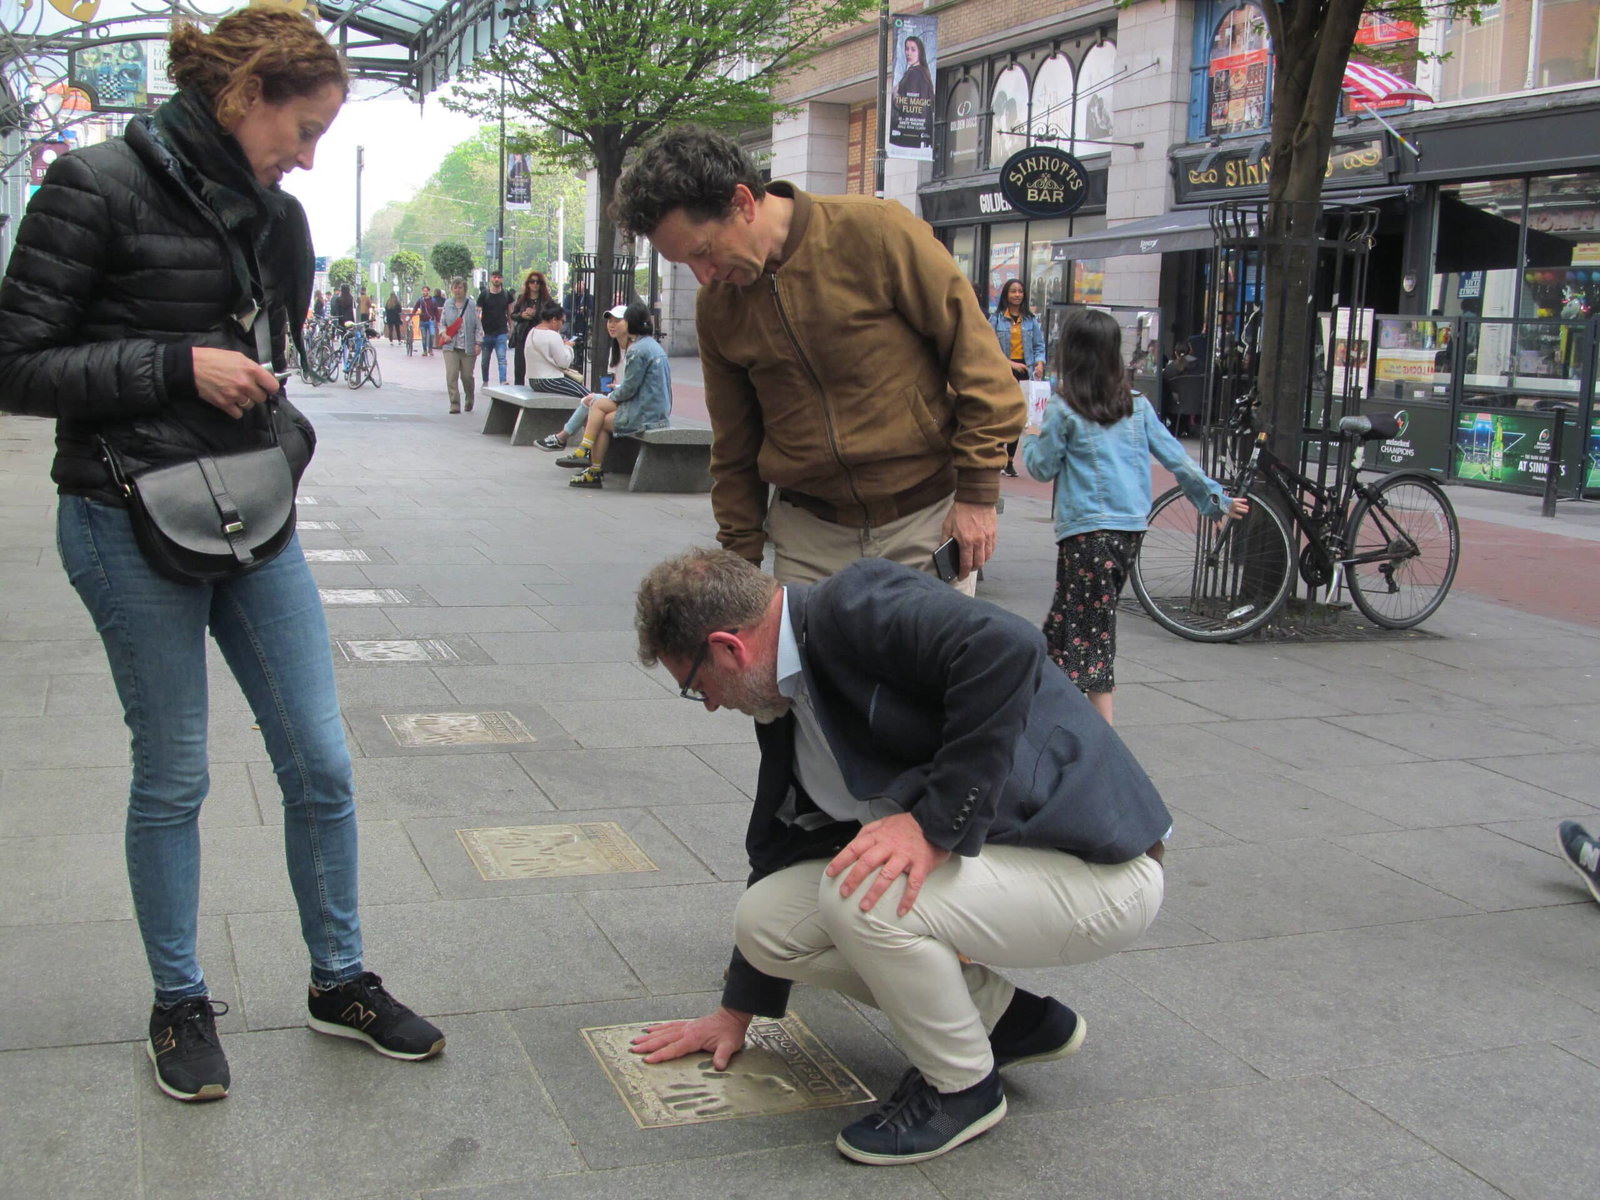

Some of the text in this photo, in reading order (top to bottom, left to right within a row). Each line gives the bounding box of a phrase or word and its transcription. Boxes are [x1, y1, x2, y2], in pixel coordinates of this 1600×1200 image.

[895, 96, 931, 106] THE MAGIC
[902, 105, 923, 113] FLUTE
[1027, 188, 1064, 203] BAR
[1380, 445, 1415, 457] CHAMPIONS
[1390, 455, 1404, 463] CUP
[1518, 461, 1527, 472] AT
[761, 1027, 809, 1066] Keogh
